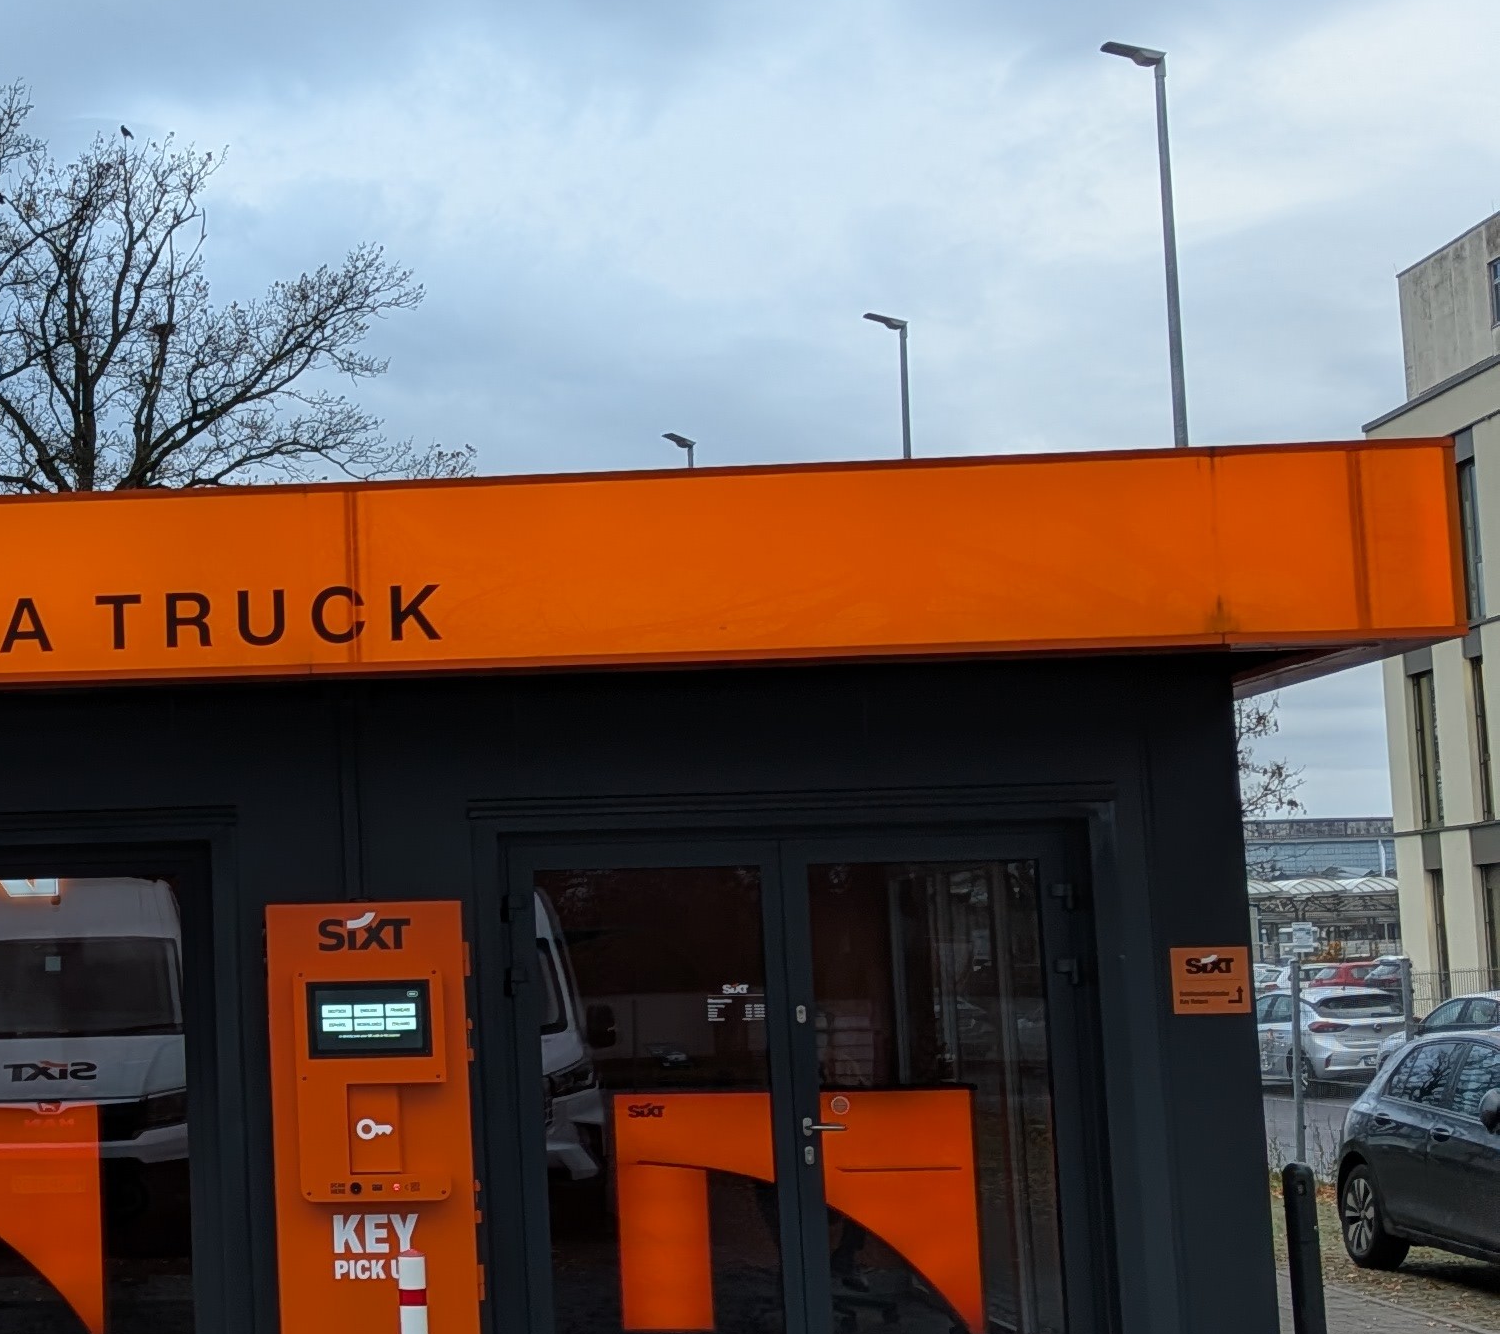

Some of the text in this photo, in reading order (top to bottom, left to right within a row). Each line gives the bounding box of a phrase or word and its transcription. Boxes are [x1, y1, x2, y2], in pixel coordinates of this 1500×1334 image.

[1, 597, 53, 655] A
[95, 583, 442, 651] TRUCK
[333, 1213, 419, 1254] KEY
[334, 1259, 387, 1280] PICK
